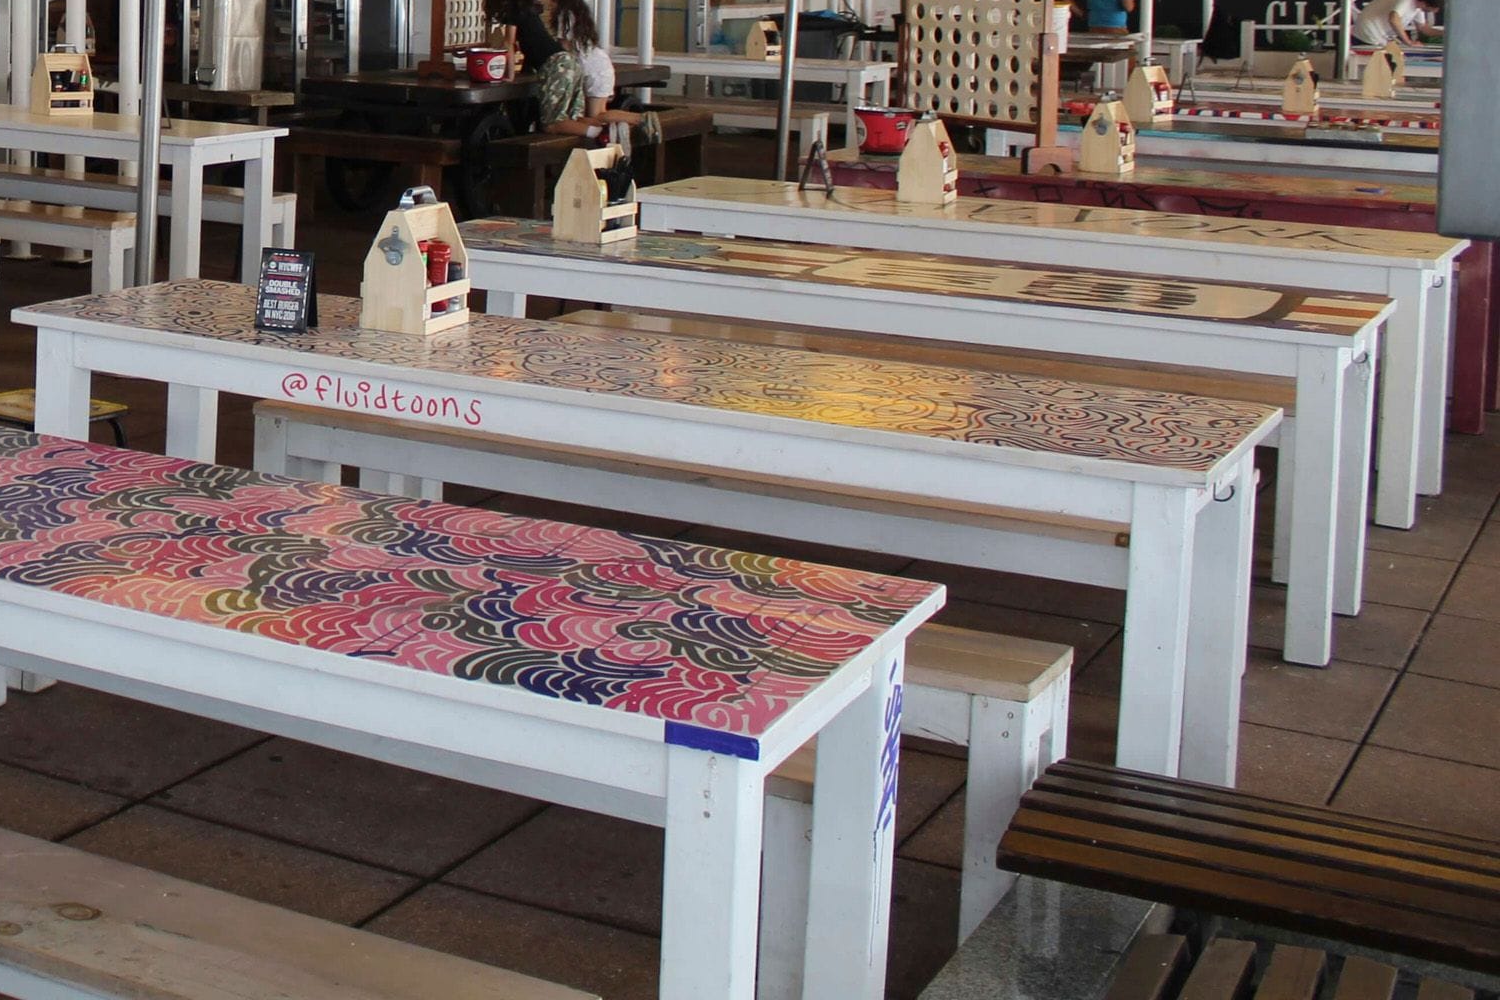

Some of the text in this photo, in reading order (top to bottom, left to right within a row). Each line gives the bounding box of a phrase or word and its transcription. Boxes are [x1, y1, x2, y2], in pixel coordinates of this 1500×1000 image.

[268, 279, 298, 289] DOUBLE
[264, 286, 301, 296] SMASHED
[263, 299, 300, 311] BEST BURGER
[282, 373, 481, 425] @fluidtoons
